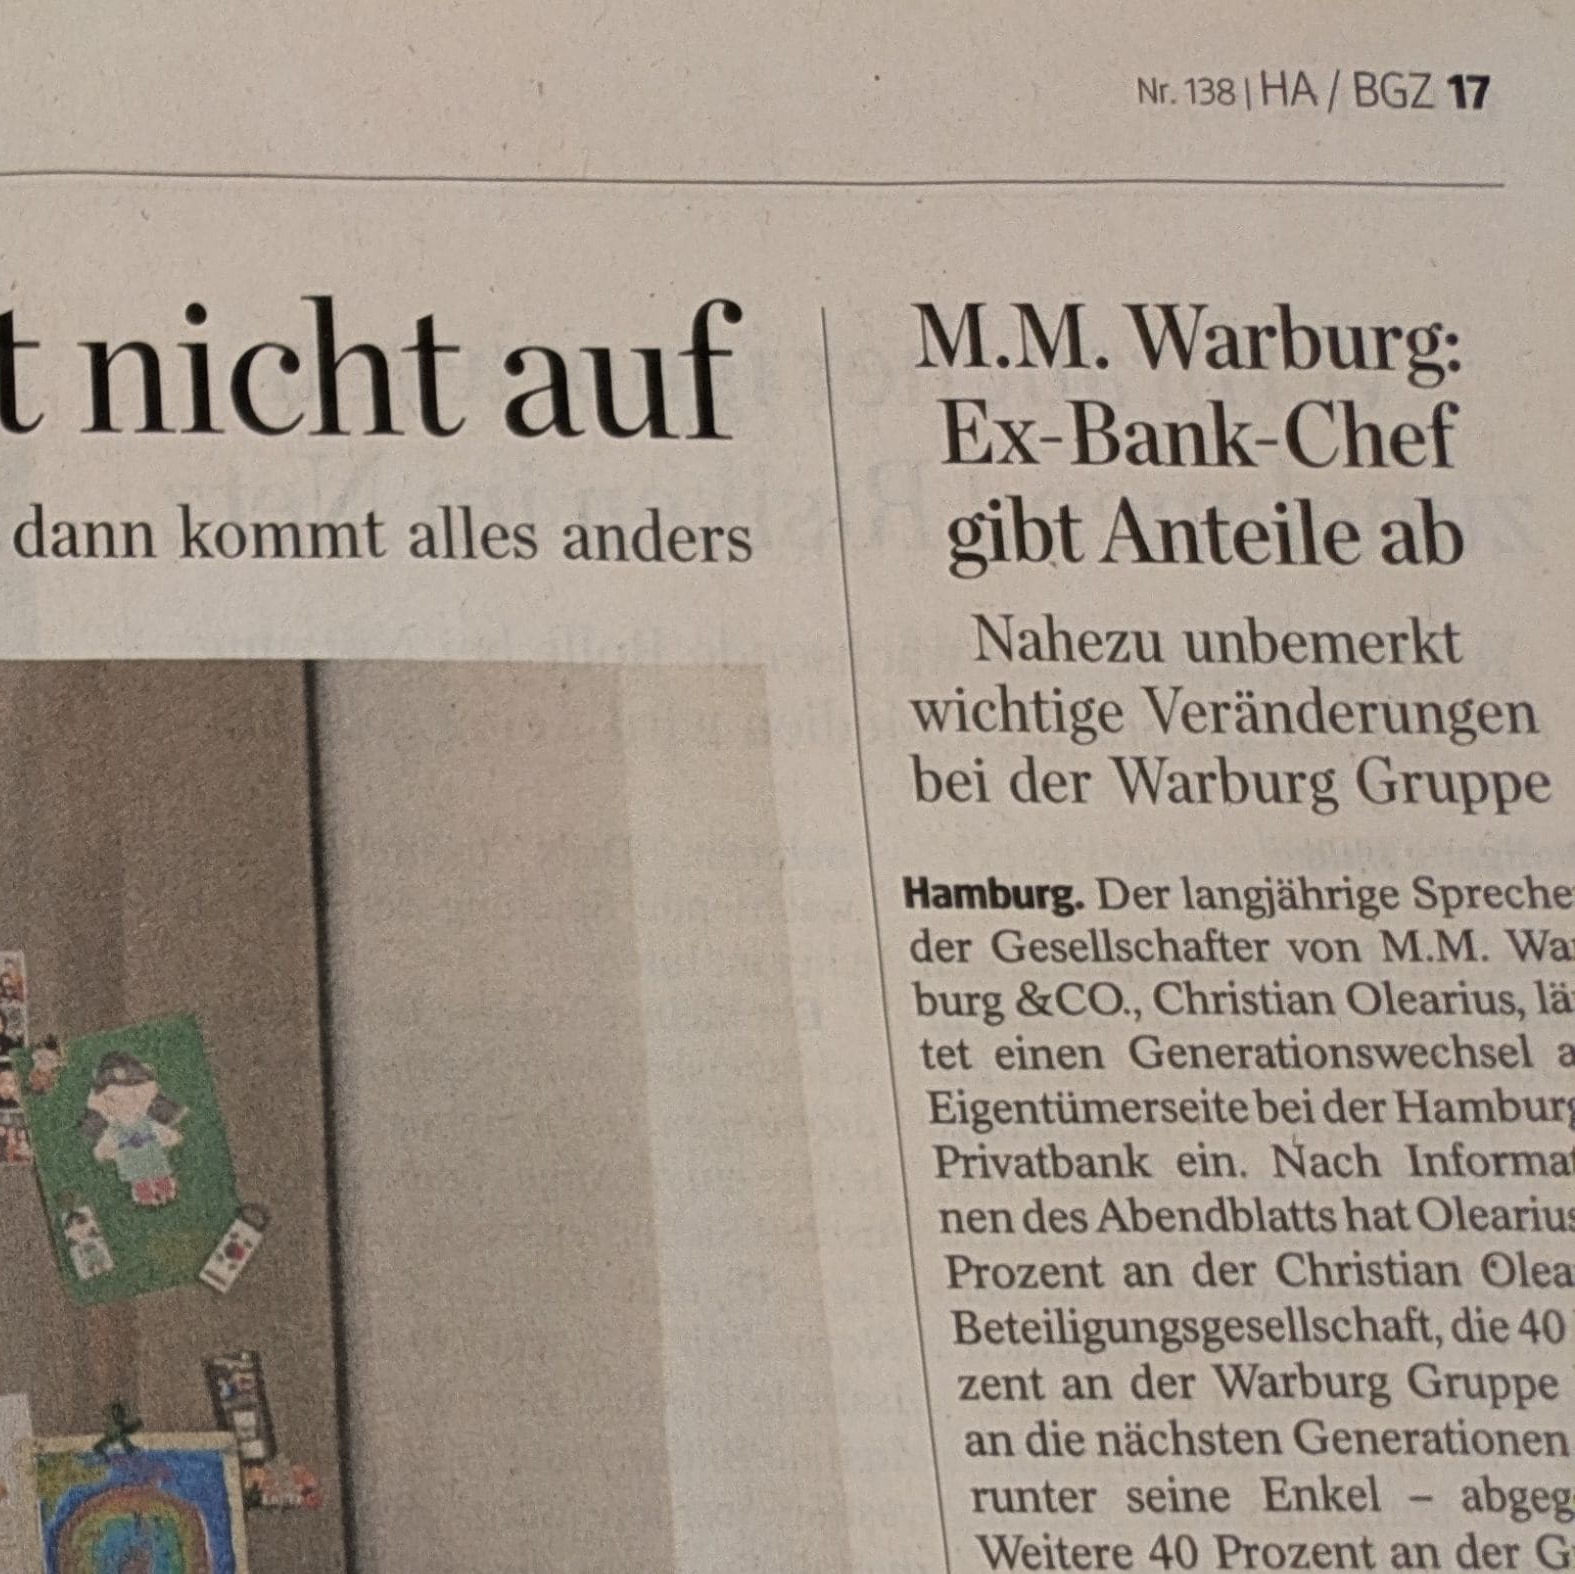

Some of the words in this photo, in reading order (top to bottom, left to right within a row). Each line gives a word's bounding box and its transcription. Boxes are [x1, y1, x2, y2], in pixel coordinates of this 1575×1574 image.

[1137, 76, 1177, 105] Nr.
[1185, 76, 1236, 107] 138
[1260, 68, 1319, 108] HA
[1353, 71, 1436, 110] BGZ
[1446, 74, 1492, 110] 17
[77, 294, 466, 438] nicht
[503, 298, 742, 440] auf
[911, 302, 1109, 370] M.M.
[1122, 302, 1461, 389] Warburg:
[937, 398, 1460, 469] Ex-Bank-Chef
[13, 502, 157, 559] dann
[178, 503, 386, 559] kommt
[409, 504, 538, 560] alles
[563, 507, 753, 563] anders
[947, 494, 1085, 580] gibt
[1098, 495, 1361, 566] Anteile
[1380, 497, 1465, 566] ab
[971, 612, 1165, 664] Nahezu
[1182, 615, 1464, 665] unbemerkt
[909, 682, 1124, 746] wichtige
[1140, 685, 1541, 747] Veränderungen
[909, 753, 991, 803] bei
[1009, 754, 1092, 804] der
[1108, 755, 1340, 816] Warburg
[1356, 755, 1551, 816] Gruppe
[902, 875, 1086, 919] Hamburg.
[1095, 876, 1171, 911] Der
[1180, 875, 1400, 921] langjährige
[926, 1087, 1250, 1135] Eigentümerseite
[1252, 1087, 1316, 1125] bei
[1322, 1086, 1387, 1125] der
[975, 1532, 1134, 1572] Weitere
[1148, 1533, 1199, 1571] 40
[1213, 1533, 1377, 1571] Prozent
[1390, 1542, 1442, 1571] an
[1455, 1531, 1521, 1571] der
